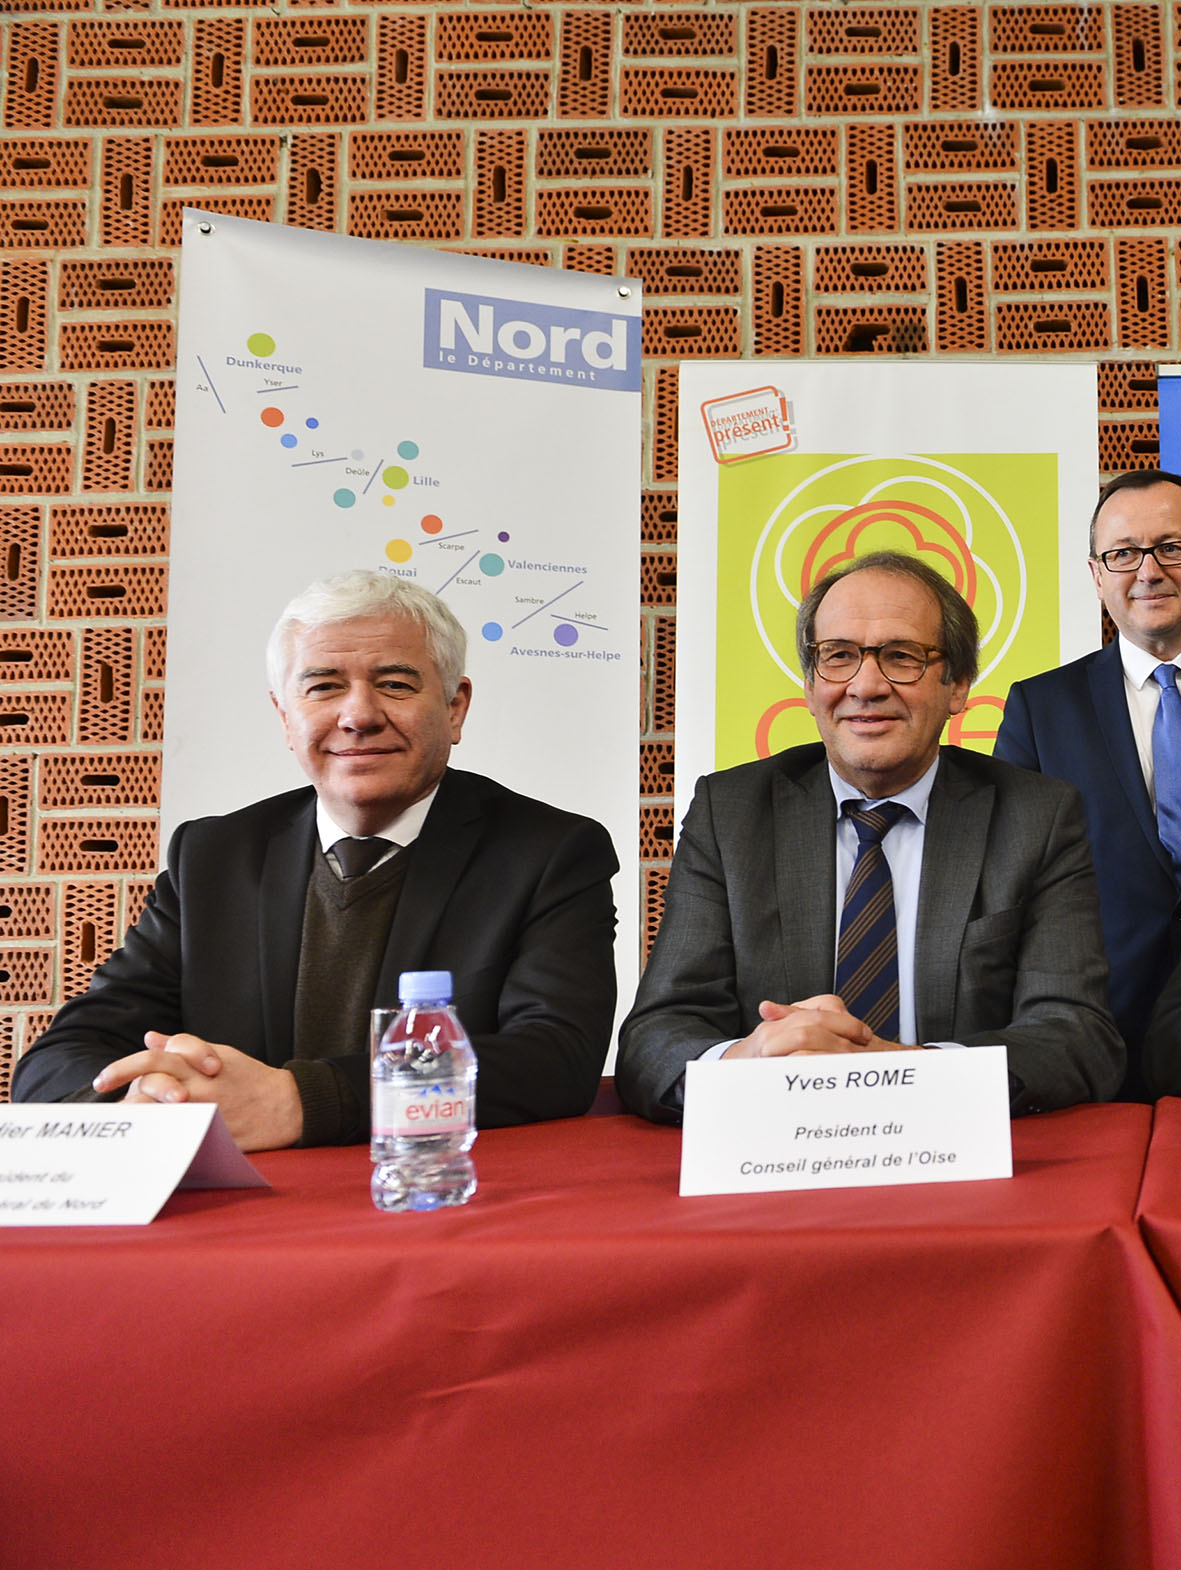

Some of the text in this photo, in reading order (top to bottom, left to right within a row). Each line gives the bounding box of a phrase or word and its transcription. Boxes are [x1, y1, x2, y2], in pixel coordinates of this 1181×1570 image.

[439, 299, 628, 371] Nord
[226, 356, 303, 375] Dunkerque
[439, 350, 597, 381] le Département
[196, 384, 209, 392] Aa
[264, 378, 282, 387] Yser
[311, 449, 324, 458] Lys
[413, 476, 440, 487] Lille
[438, 543, 465, 551] Scarpe
[508, 560, 588, 574] Valenciennes
[456, 577, 482, 586] Escaut
[515, 596, 544, 604] Sambre
[575, 611, 597, 620] Helpe
[510, 646, 621, 661] Avesnes-sur-Helpe
[784, 1068, 916, 1092] Yves ROME
[406, 1100, 465, 1121] evian
[36, 1121, 132, 1138] MANIER
[795, 1121, 904, 1140] Président du
[740, 1158, 807, 1176] Conseil
[811, 1154, 877, 1174] général
[882, 1152, 903, 1167] de
